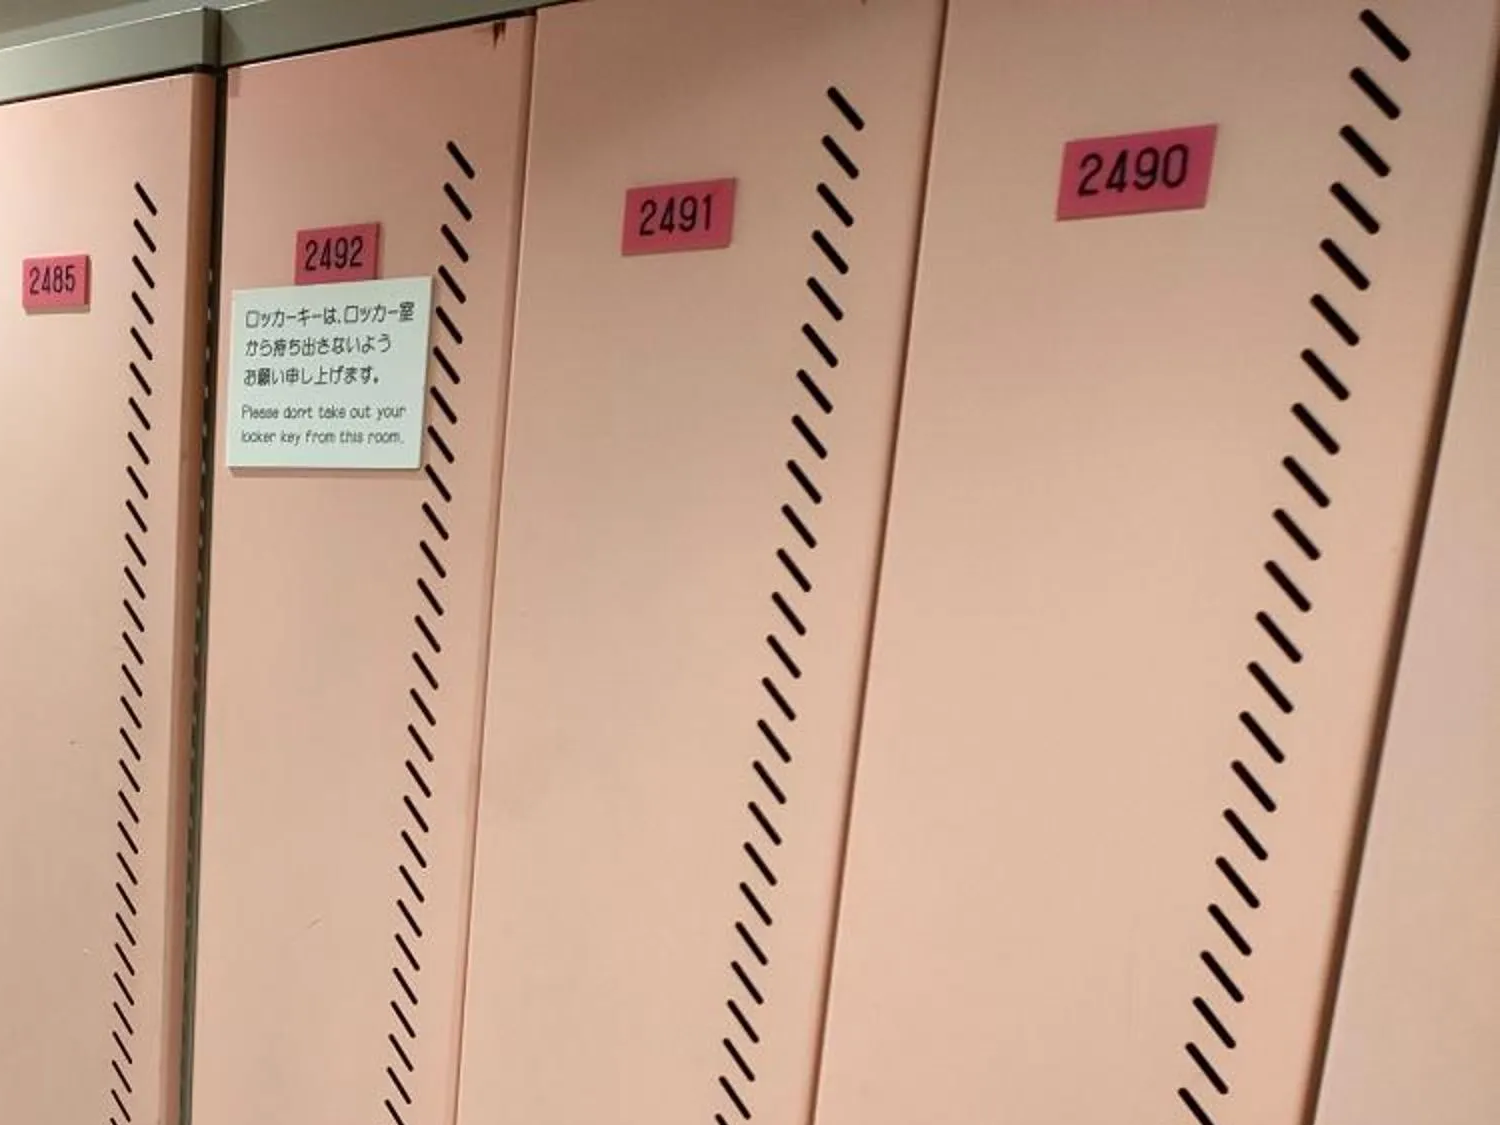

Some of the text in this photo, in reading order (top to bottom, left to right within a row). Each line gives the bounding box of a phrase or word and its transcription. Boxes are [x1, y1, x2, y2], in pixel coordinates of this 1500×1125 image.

[1076, 143, 1190, 197] 2490
[638, 193, 713, 237] 2491
[303, 235, 365, 272] 2492
[28, 264, 77, 296] 2485
[244, 333, 392, 358] から持ち出さないよう
[242, 365, 379, 387] お願い申し上げます。
[241, 403, 279, 419] Please
[318, 404, 346, 419] take
[349, 405, 372, 419] out
[376, 405, 406, 422] your
[240, 429, 277, 443] locker
[280, 429, 300, 447] key
[305, 429, 336, 444] from
[339, 428, 363, 443] this
